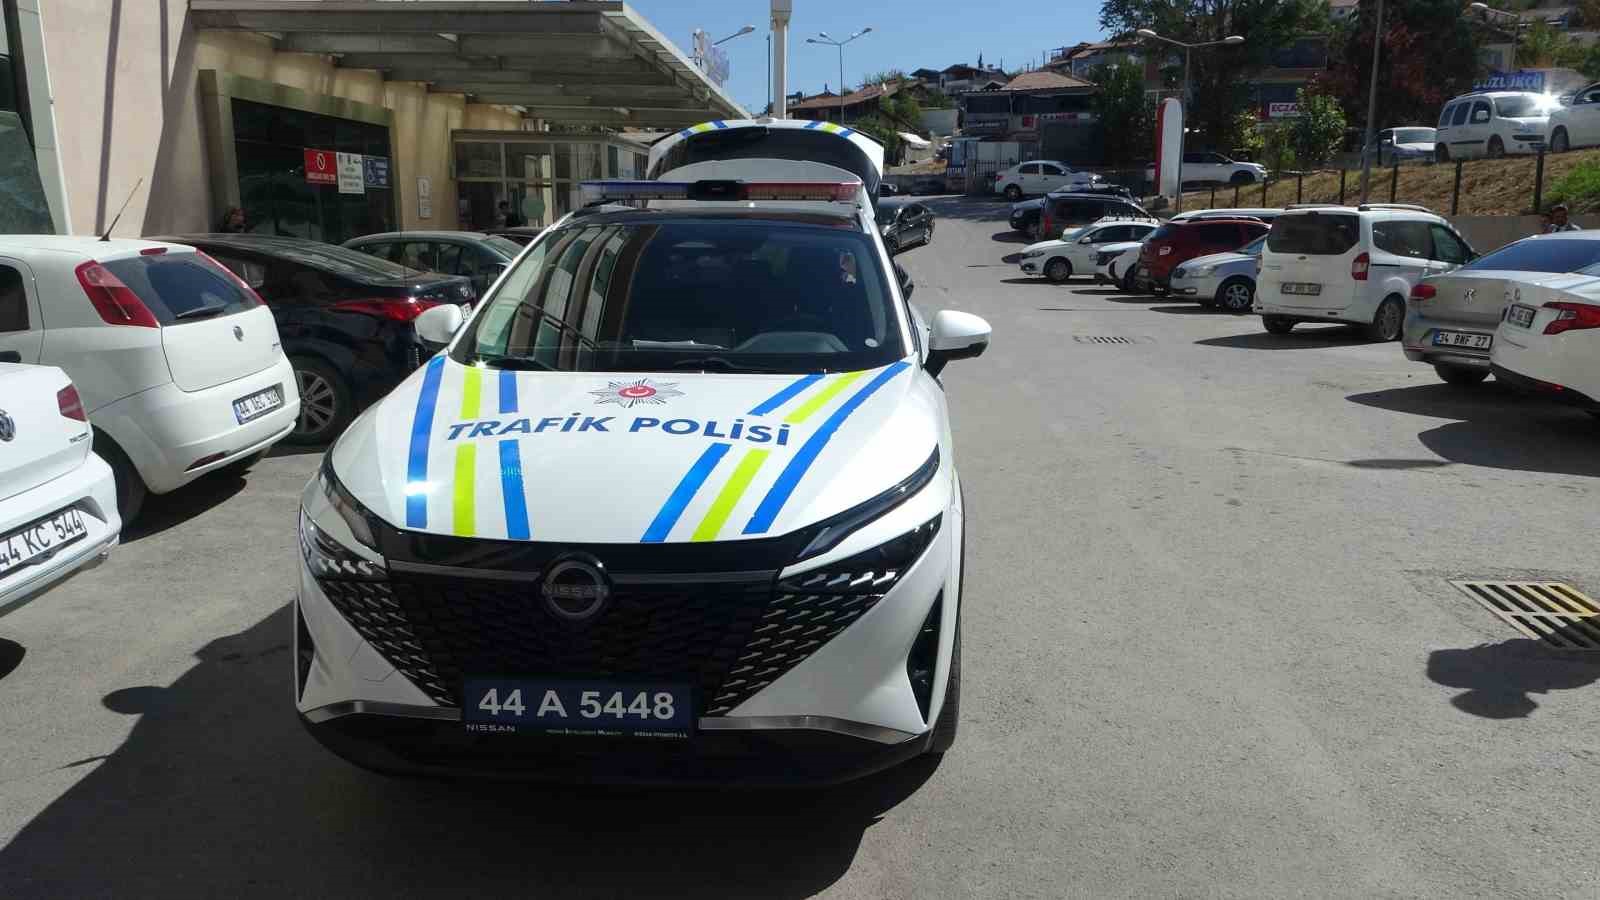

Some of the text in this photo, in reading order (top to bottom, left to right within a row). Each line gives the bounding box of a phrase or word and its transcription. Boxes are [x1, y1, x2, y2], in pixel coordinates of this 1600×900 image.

[448, 412, 790, 446] TRAFİK POLİSİ
[22, 524, 51, 555] KC
[52, 510, 84, 540] 544
[479, 688, 676, 720] 44 A 5448
[466, 724, 516, 733] NISSAN
